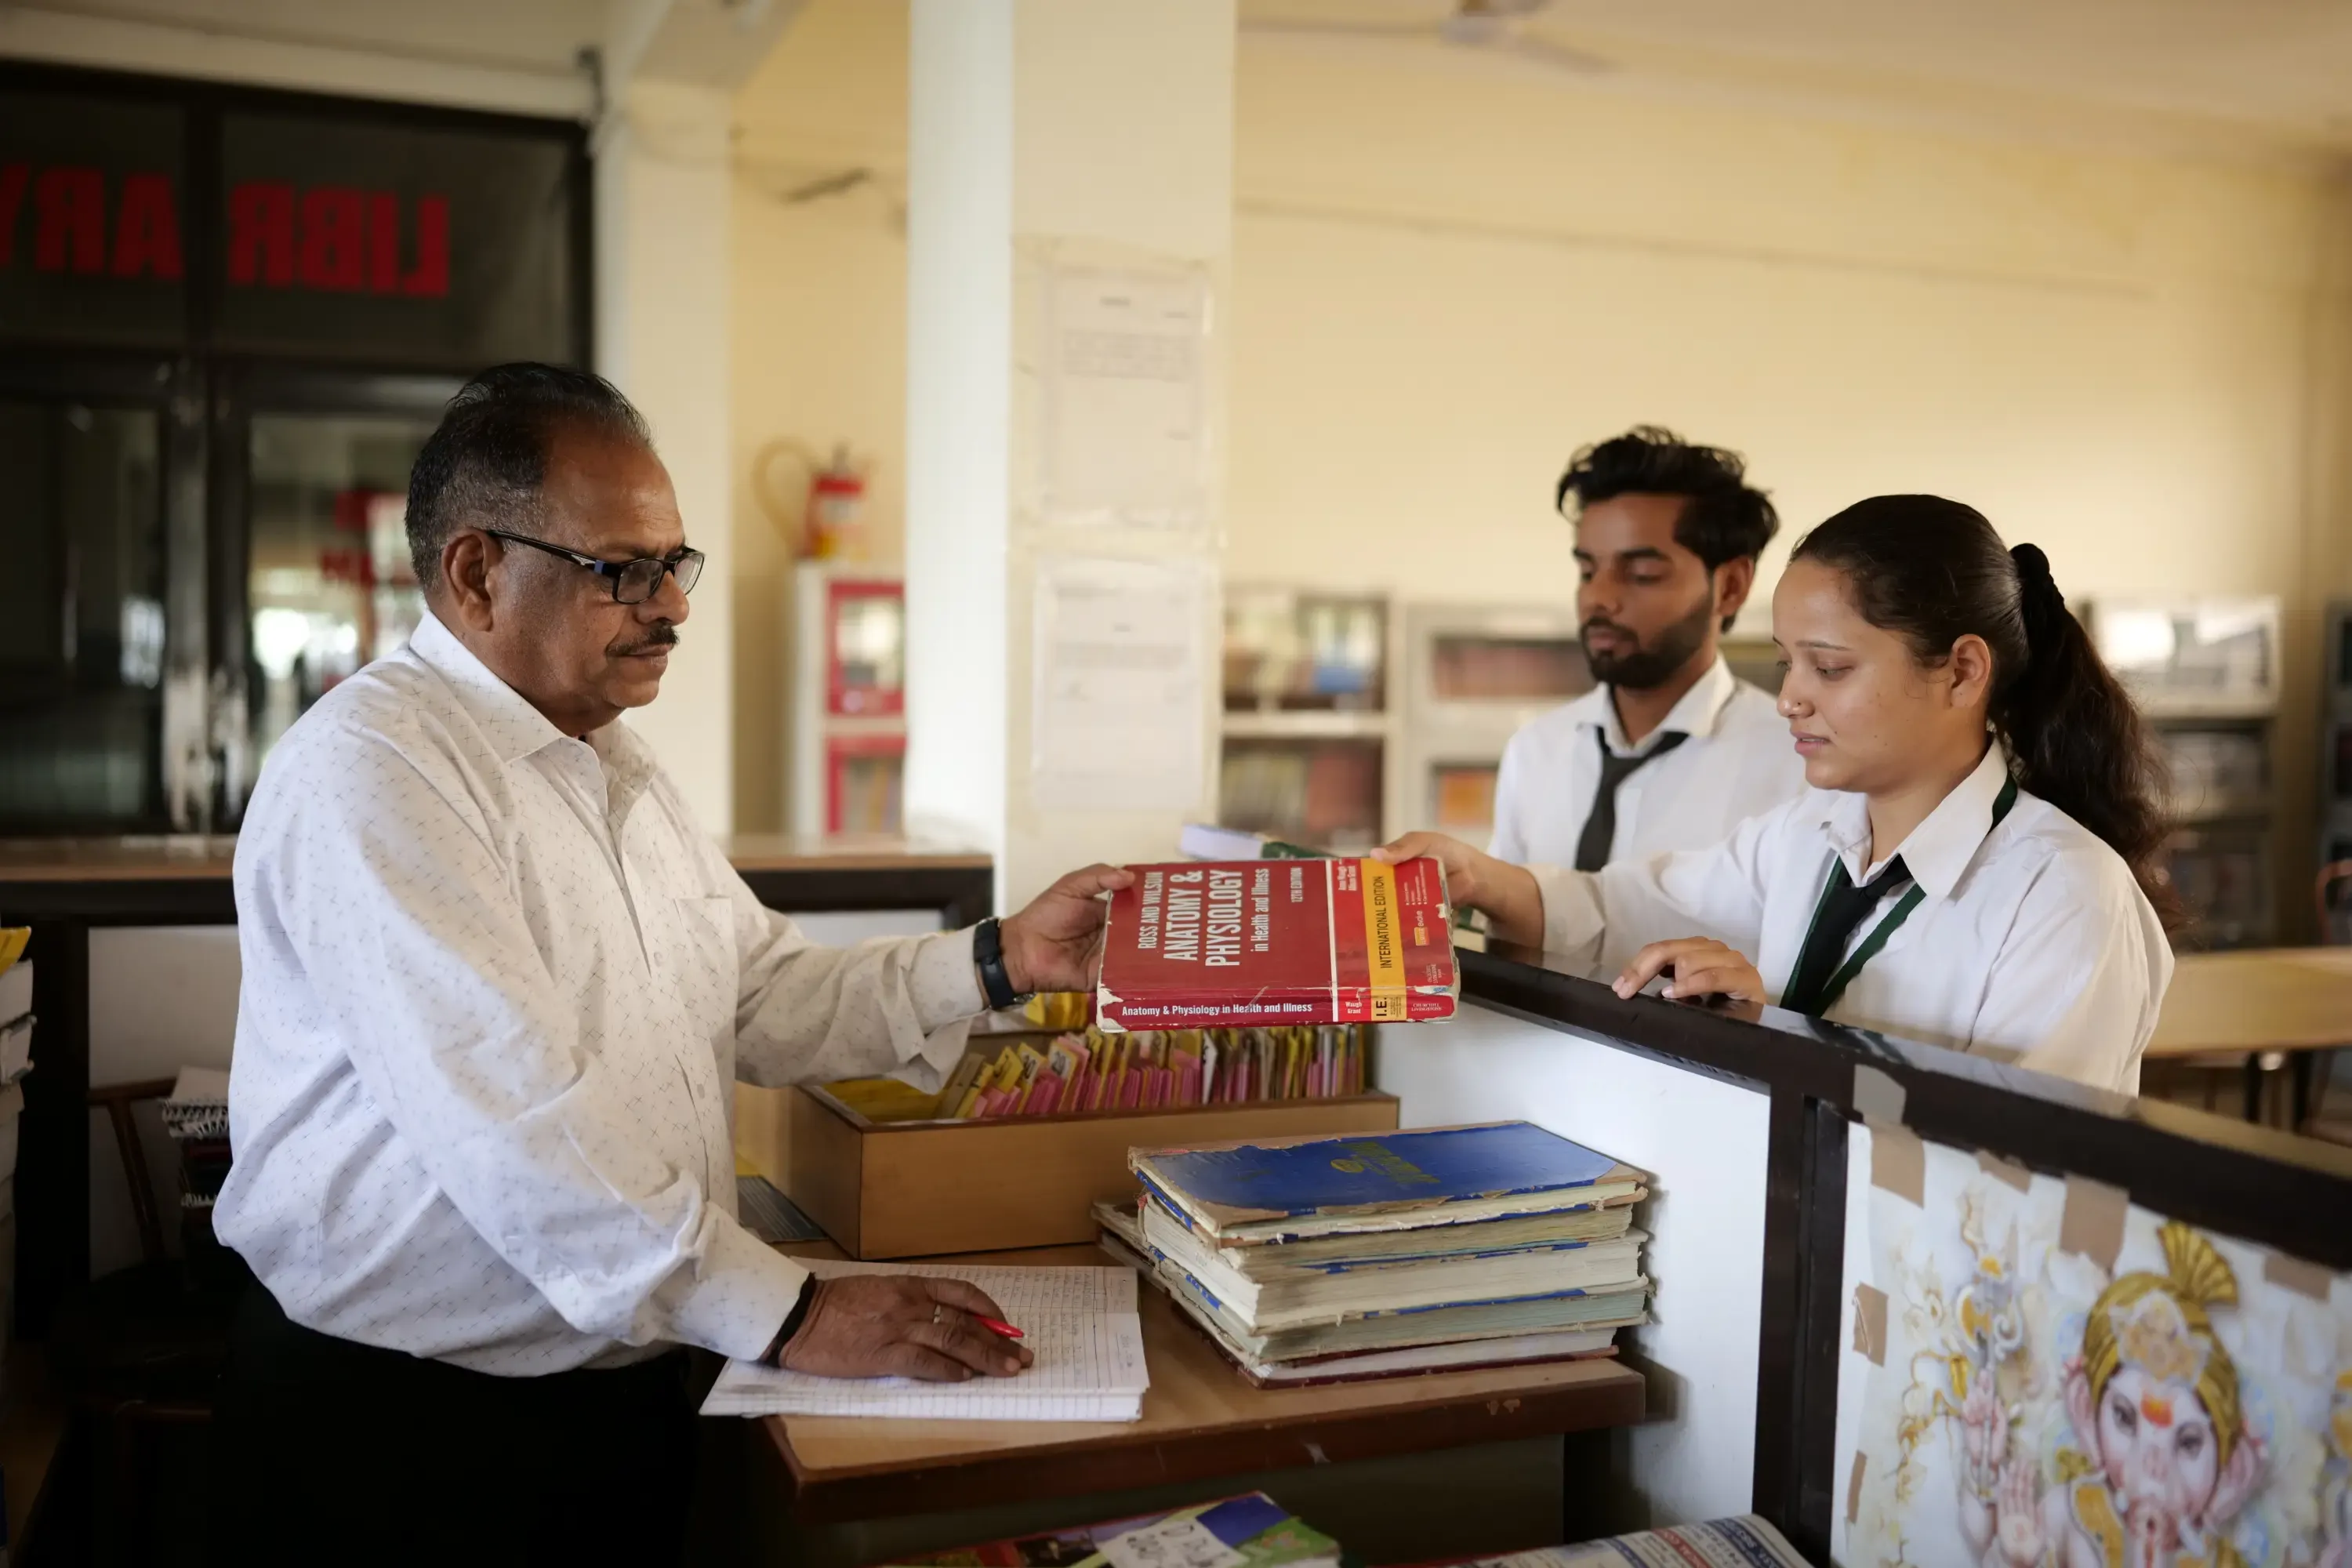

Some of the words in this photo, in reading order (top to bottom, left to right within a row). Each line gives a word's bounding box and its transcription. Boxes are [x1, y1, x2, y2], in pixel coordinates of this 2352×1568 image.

[1169, 869, 1203, 883] &
[1251, 868, 1269, 895] Illness
[1290, 867, 1302, 889] EDITION
[1142, 872, 1163, 905] WILSON
[1290, 890, 1303, 902] 12TH
[1373, 876, 1387, 906] EDITION
[1141, 906, 1160, 924] AND
[1251, 897, 1269, 913] and
[1163, 887, 1202, 961] ANATOMY
[1205, 869, 1242, 966] PHYSIOLOGY
[1250, 914, 1269, 941] Health
[1138, 926, 1158, 949] ROSS
[1250, 943, 1269, 952] in
[1375, 907, 1392, 969] INTERNATIONAL
[1122, 1006, 1160, 1016] Anatomy
[1163, 1006, 1170, 1014] &
[1172, 1004, 1220, 1016] Physiology
[1222, 1004, 1230, 1014] in
[1233, 1004, 1261, 1013] Health
[1264, 1004, 1280, 1013] and
[1283, 1003, 1312, 1012] Illness
[1376, 997, 1387, 1017] I.E.
